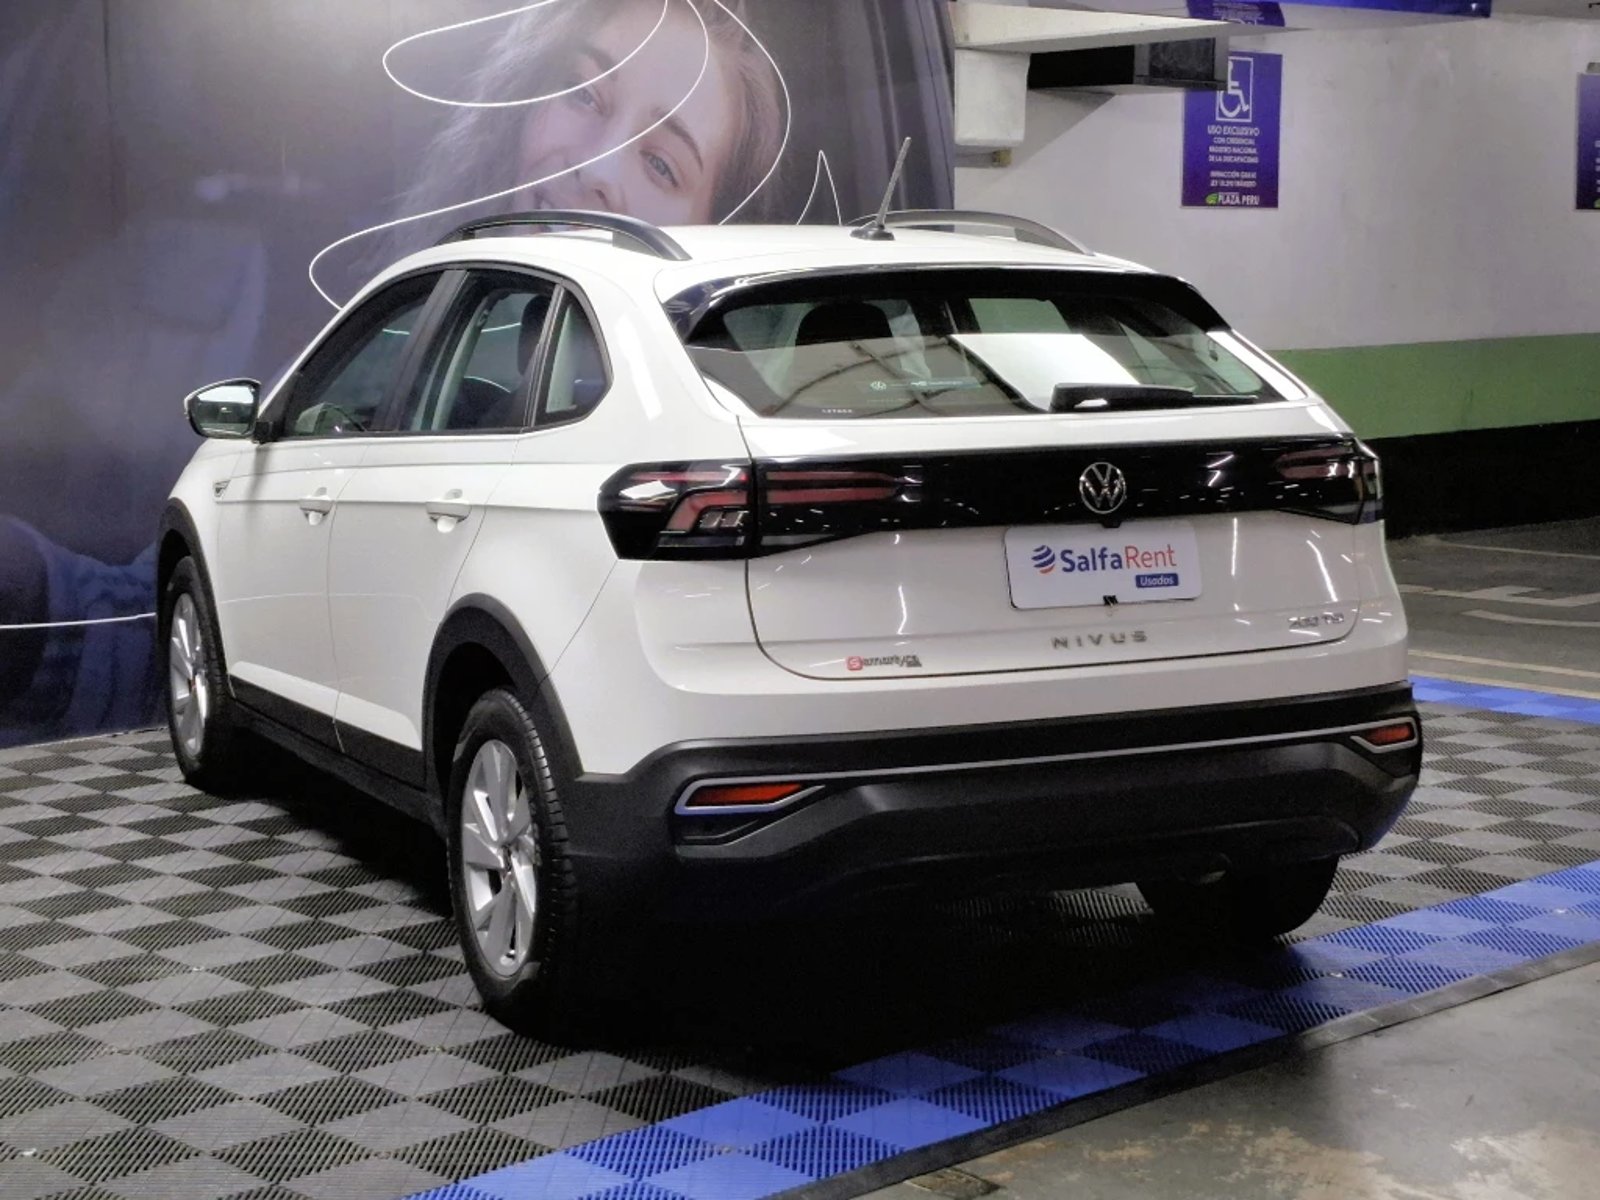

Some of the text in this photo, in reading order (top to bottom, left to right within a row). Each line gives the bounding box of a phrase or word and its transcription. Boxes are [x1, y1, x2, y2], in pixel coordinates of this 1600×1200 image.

[1207, 124, 1260, 137] USO EXCLUSIVO
[1219, 194, 1240, 206] PLAZA
[1060, 544, 1178, 573] SalfaRent
[1140, 574, 1175, 587] Usados
[1051, 630, 1148, 650] NIVUS
